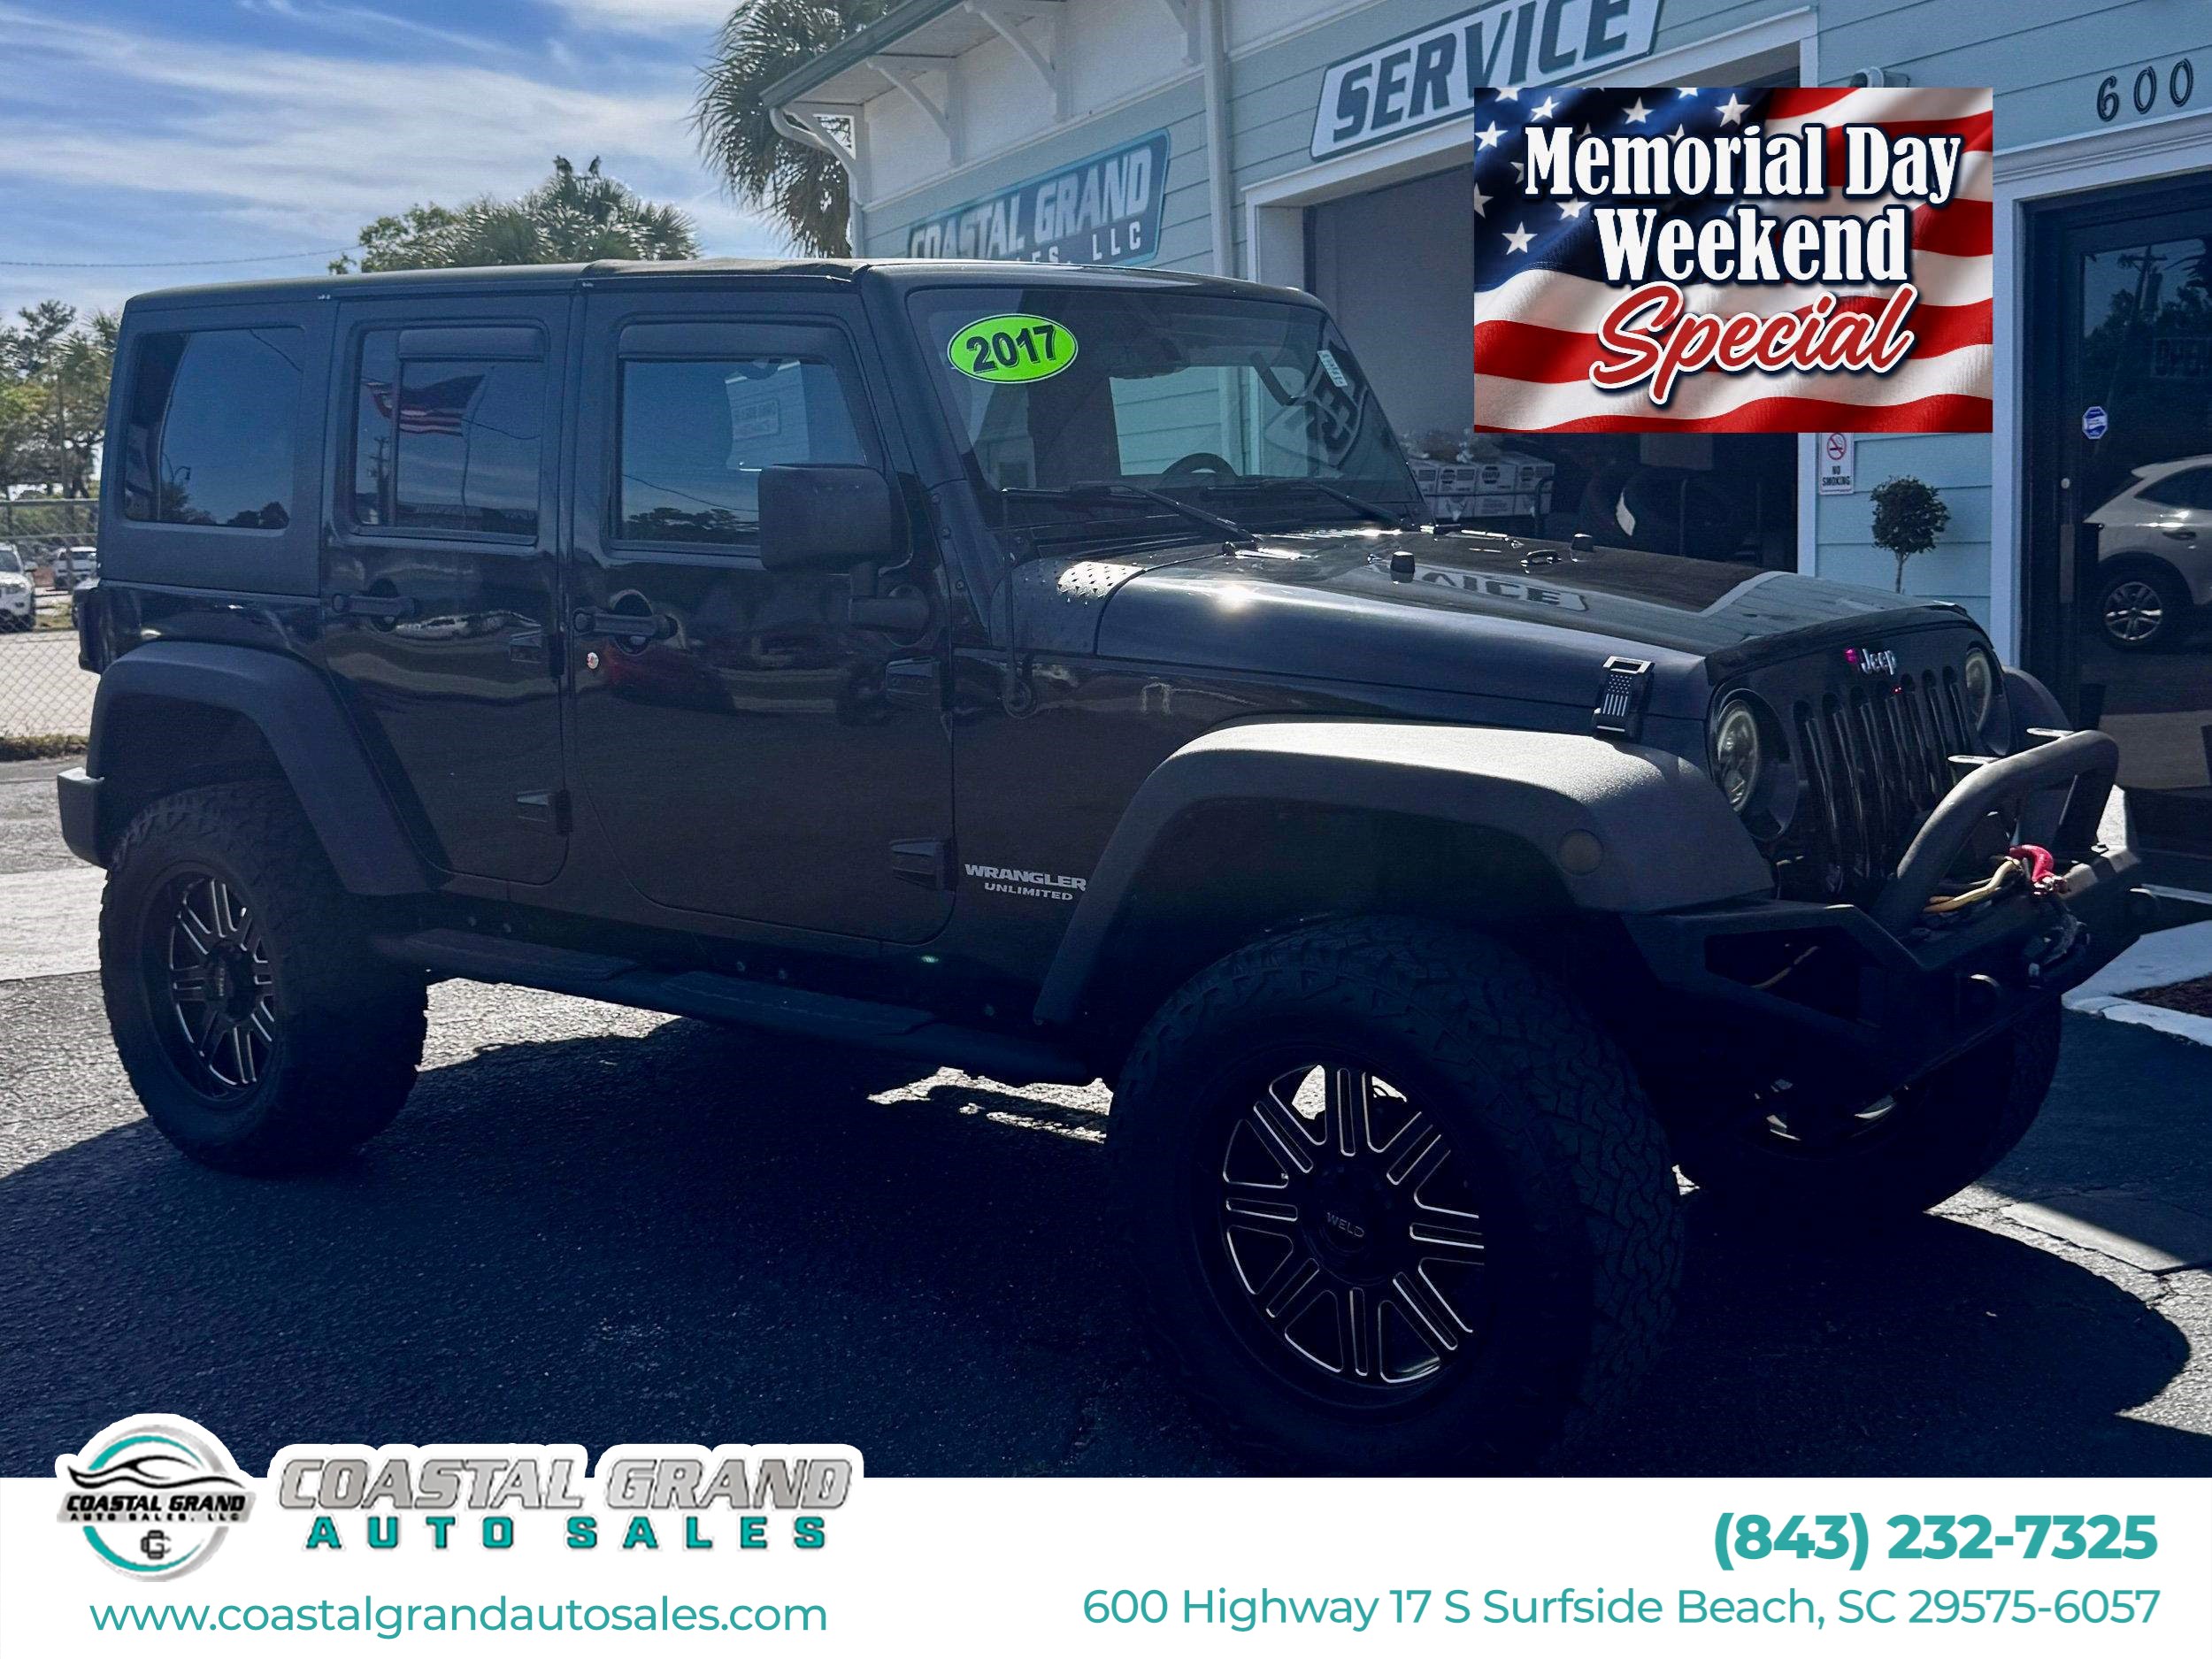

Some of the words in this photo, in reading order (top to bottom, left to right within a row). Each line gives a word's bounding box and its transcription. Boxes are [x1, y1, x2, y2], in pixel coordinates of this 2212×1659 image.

[1333, 0, 1631, 143] SERVICE
[2096, 58, 2193, 122] 600
[1034, 145, 1152, 244] GRAND
[1092, 220, 1142, 262] LLC
[966, 324, 1057, 374] 2017
[1822, 476, 1851, 486] SMOKING
[1832, 465, 1841, 475] NO
[1861, 648, 1897, 676] Jeep
[964, 864, 1087, 891] WRANGLER
[984, 881, 1073, 901] UNLIMITED
[1325, 1211, 1365, 1239] WELD
